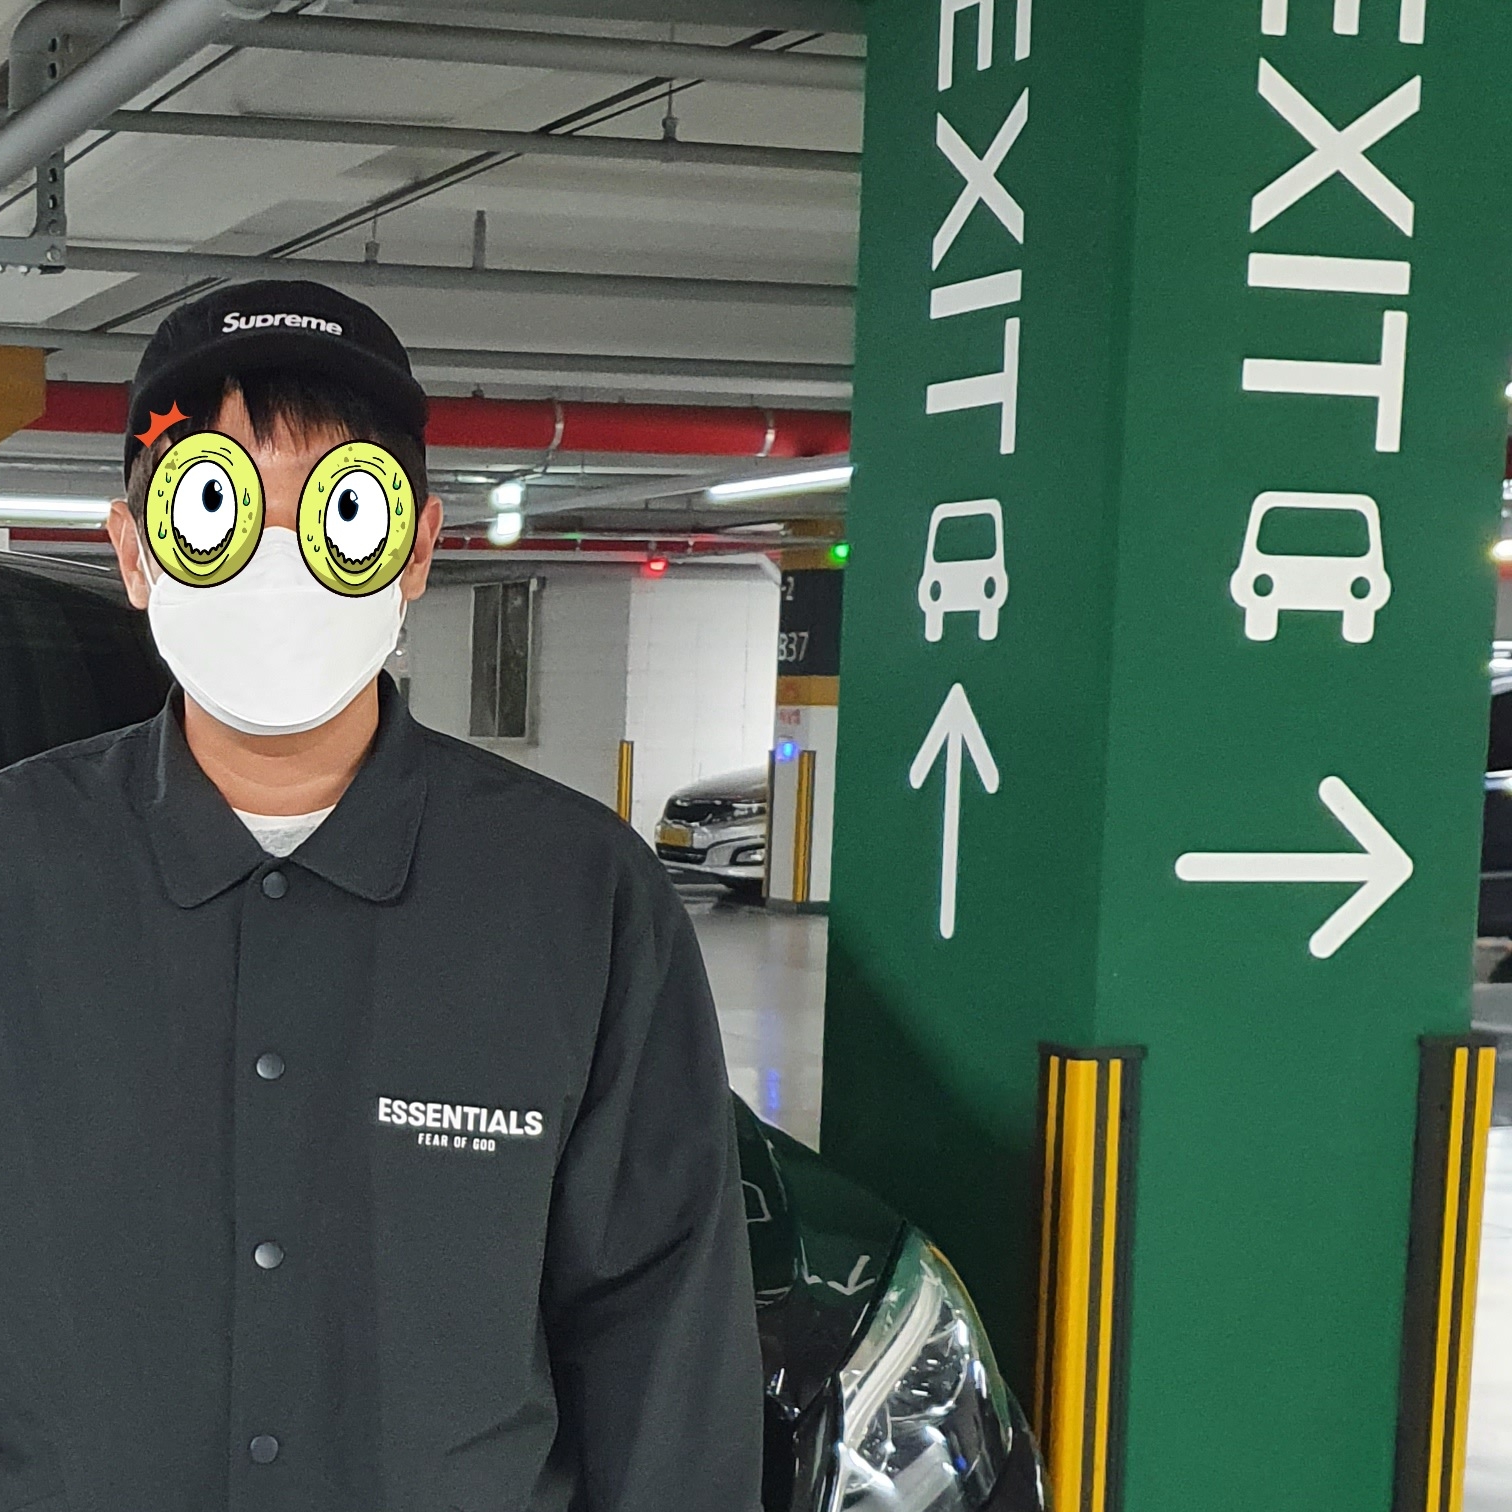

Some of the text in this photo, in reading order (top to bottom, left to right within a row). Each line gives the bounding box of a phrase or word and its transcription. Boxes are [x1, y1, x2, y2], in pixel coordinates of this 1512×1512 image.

[222, 312, 343, 336] Supreme
[378, 1097, 543, 1136] ESSENTIALS
[418, 1132, 496, 1152] FEAR OF GOD
